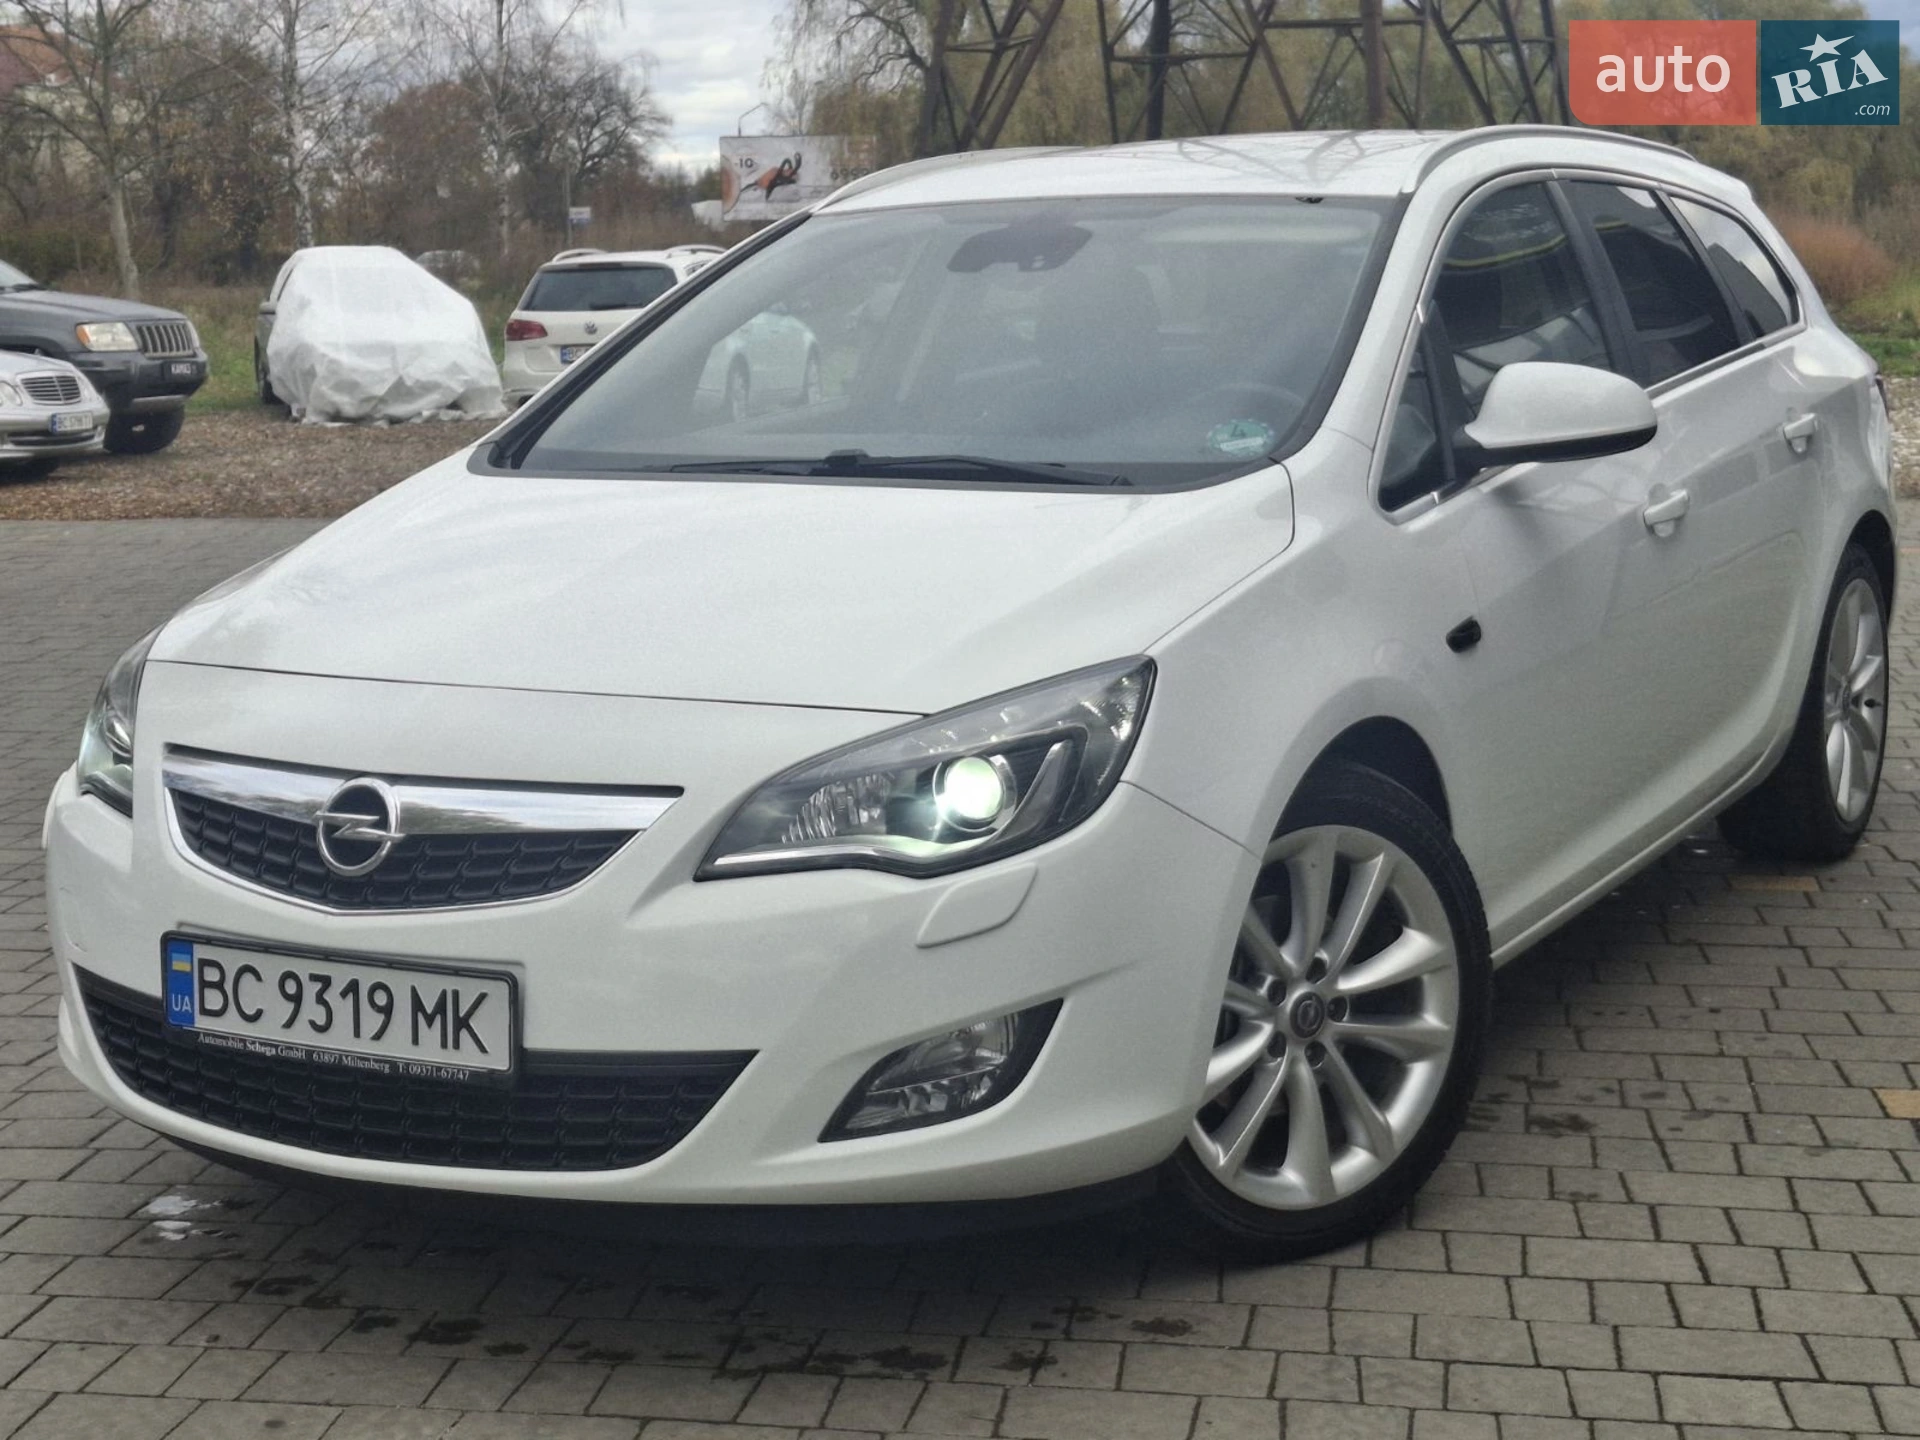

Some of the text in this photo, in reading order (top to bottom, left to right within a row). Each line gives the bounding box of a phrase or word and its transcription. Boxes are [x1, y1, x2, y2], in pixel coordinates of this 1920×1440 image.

[172, 994, 192, 1014] UA
[198, 957, 489, 1054] BC 9319 MK
[199, 1033, 245, 1050] Automobile
[278, 1046, 306, 1060] GmbH
[342, 1055, 390, 1074] Miltenberg
